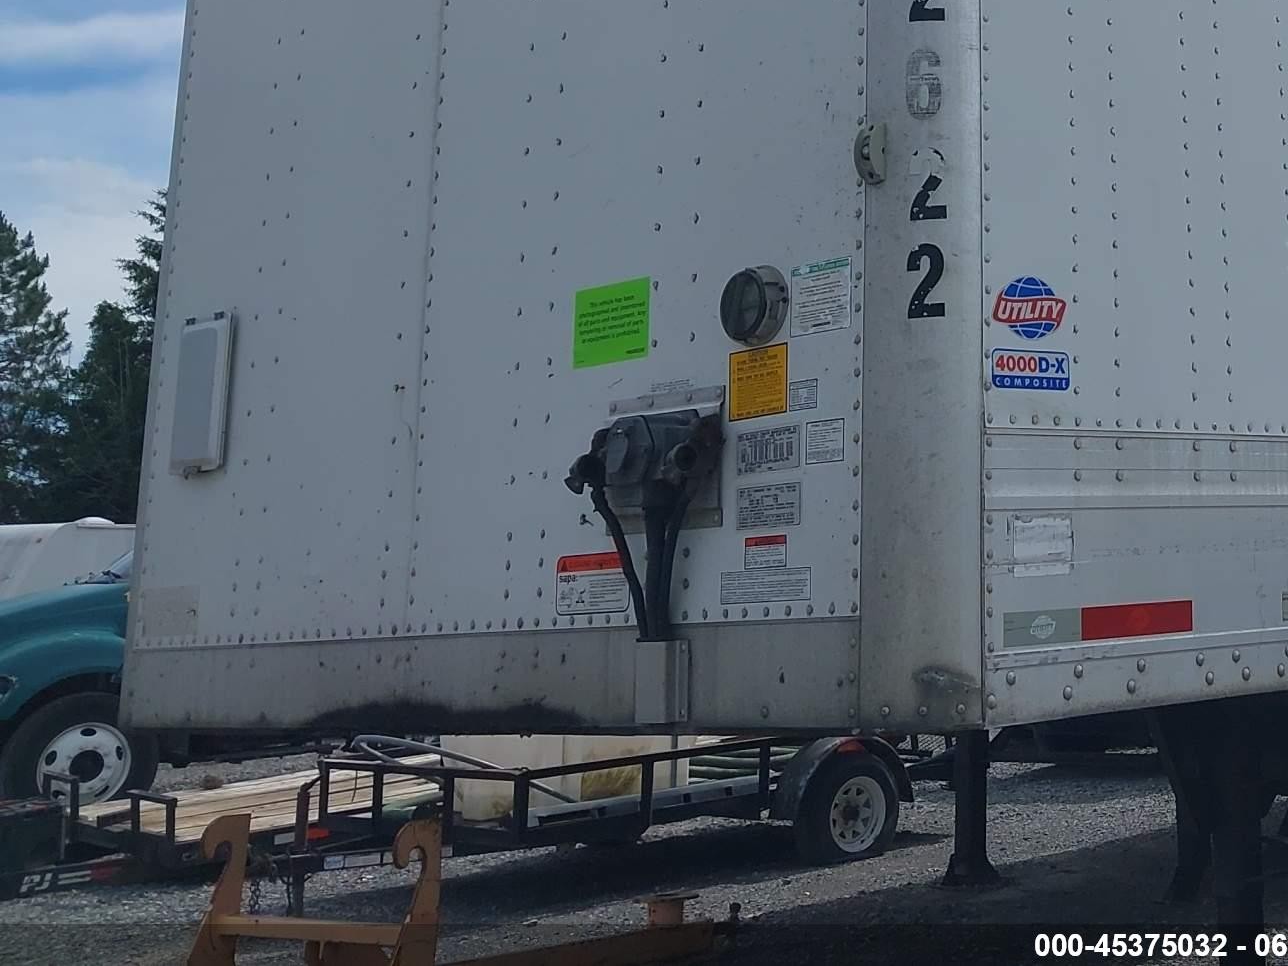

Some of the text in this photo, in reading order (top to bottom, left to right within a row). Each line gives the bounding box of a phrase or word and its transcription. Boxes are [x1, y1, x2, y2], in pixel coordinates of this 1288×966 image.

[997, 300, 1062, 320] UTILITY
[995, 355, 1066, 374] 4000D-X
[995, 378, 1067, 388] COMPOSITE
[19, 872, 53, 893] PJ
